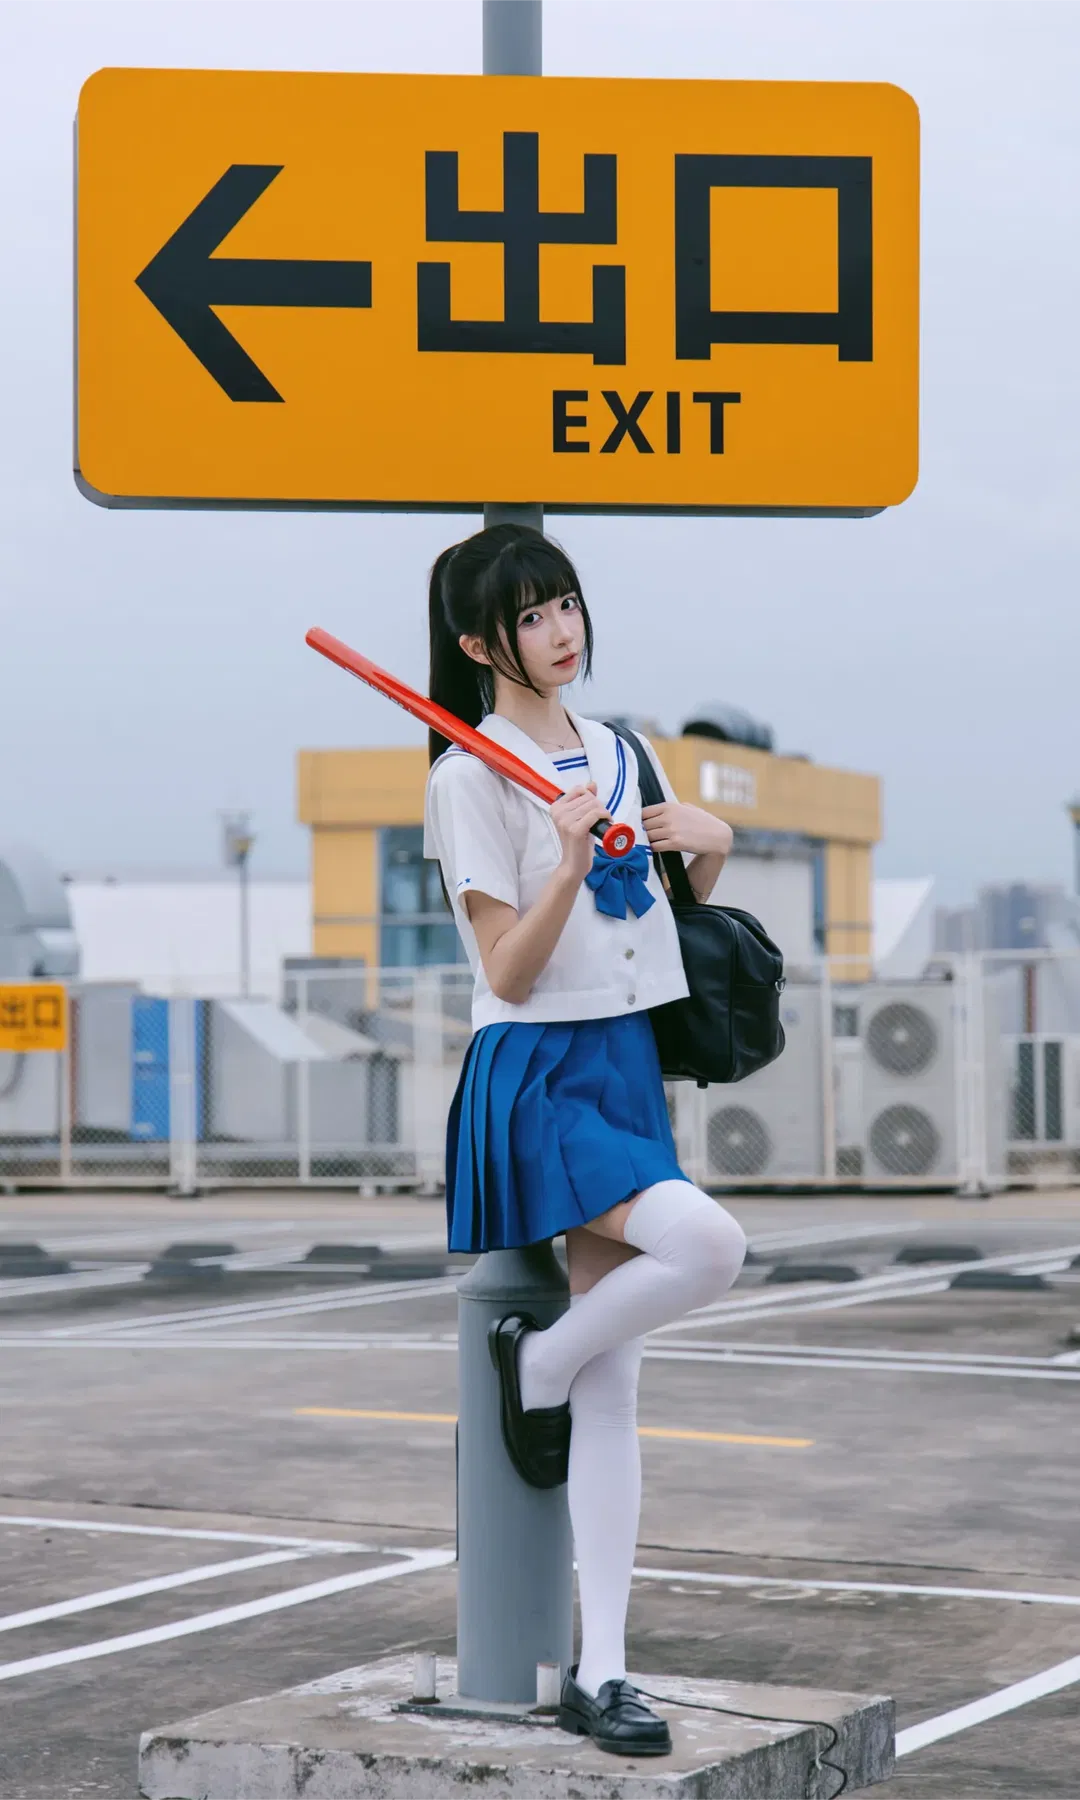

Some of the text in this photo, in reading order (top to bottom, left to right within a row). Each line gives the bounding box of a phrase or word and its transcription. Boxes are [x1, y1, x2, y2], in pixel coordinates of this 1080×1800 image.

[417, 132, 873, 365] 出口
[553, 391, 740, 454] EXIT
[0, 995, 61, 1029] 出口
